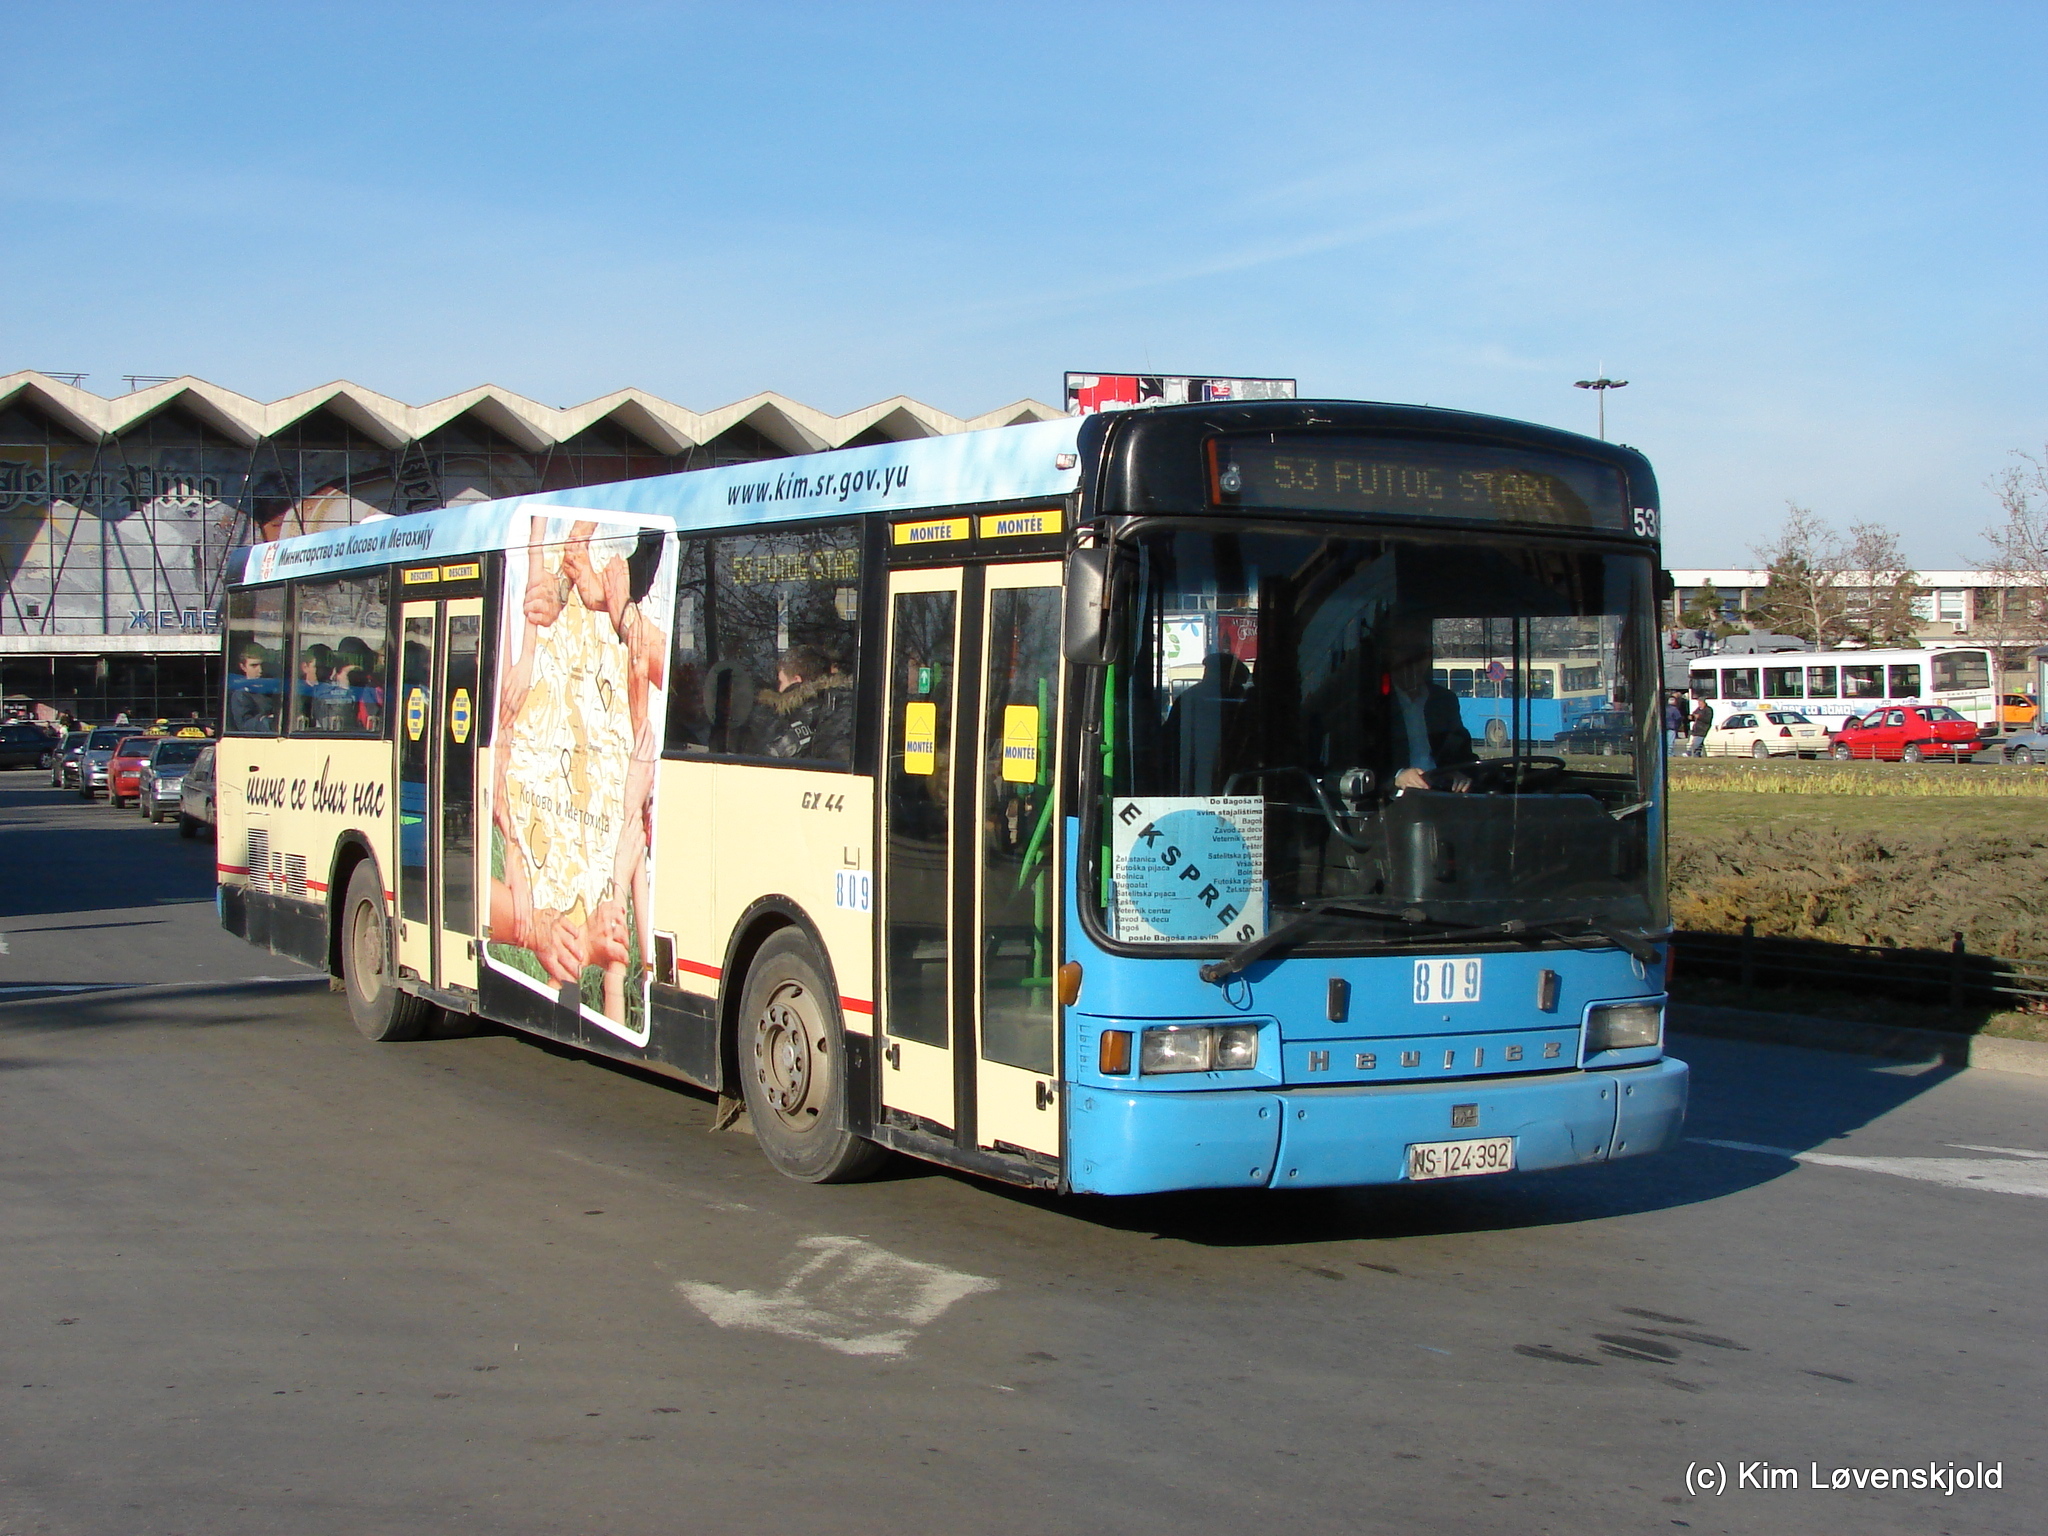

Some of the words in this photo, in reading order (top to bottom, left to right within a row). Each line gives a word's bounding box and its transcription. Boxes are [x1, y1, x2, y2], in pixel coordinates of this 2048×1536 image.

[727, 465, 909, 505] www.kim.sr.gov.yu
[1274, 456, 1318, 490] 53
[1334, 460, 1443, 499] FUTOG
[909, 522, 951, 541] MONTÉE
[997, 516, 1043, 534] MONTÉE
[278, 544, 333, 567] Министарство
[335, 542, 345, 557] за
[346, 535, 378, 555] Косово
[380, 535, 387, 550] и
[388, 523, 434, 550] Метохију
[411, 571, 433, 581] DESCENTE
[449, 566, 473, 577] DESCENTE
[129, 609, 223, 630] ЖЕЛЕ
[906, 738, 933, 754] MONTÉE
[1005, 744, 1036, 760] MONTÉE
[290, 778, 307, 811] се
[353, 781, 386, 818] нас
[801, 791, 822, 810] GX
[825, 794, 845, 812] 44
[1223, 797, 1252, 806] Bagoša
[519, 782, 552, 812] Косово
[564, 800, 610, 836] Метохија
[1218, 808, 1263, 816] stajalištima
[1242, 817, 1263, 826] Bagoš
[1214, 826, 1237, 834] Zavod
[1207, 852, 1241, 860] Satelitska
[1243, 851, 1263, 860] pijaca
[1118, 802, 1255, 944] EKSPRES
[1147, 864, 1170, 873] pijaca
[1243, 878, 1263, 886] pijaca
[836, 872, 869, 910] 809
[1154, 890, 1176, 899] pijaca
[1128, 934, 1151, 942] posle
[1154, 934, 1184, 942] Bagoša
[1415, 961, 1479, 1002] 809
